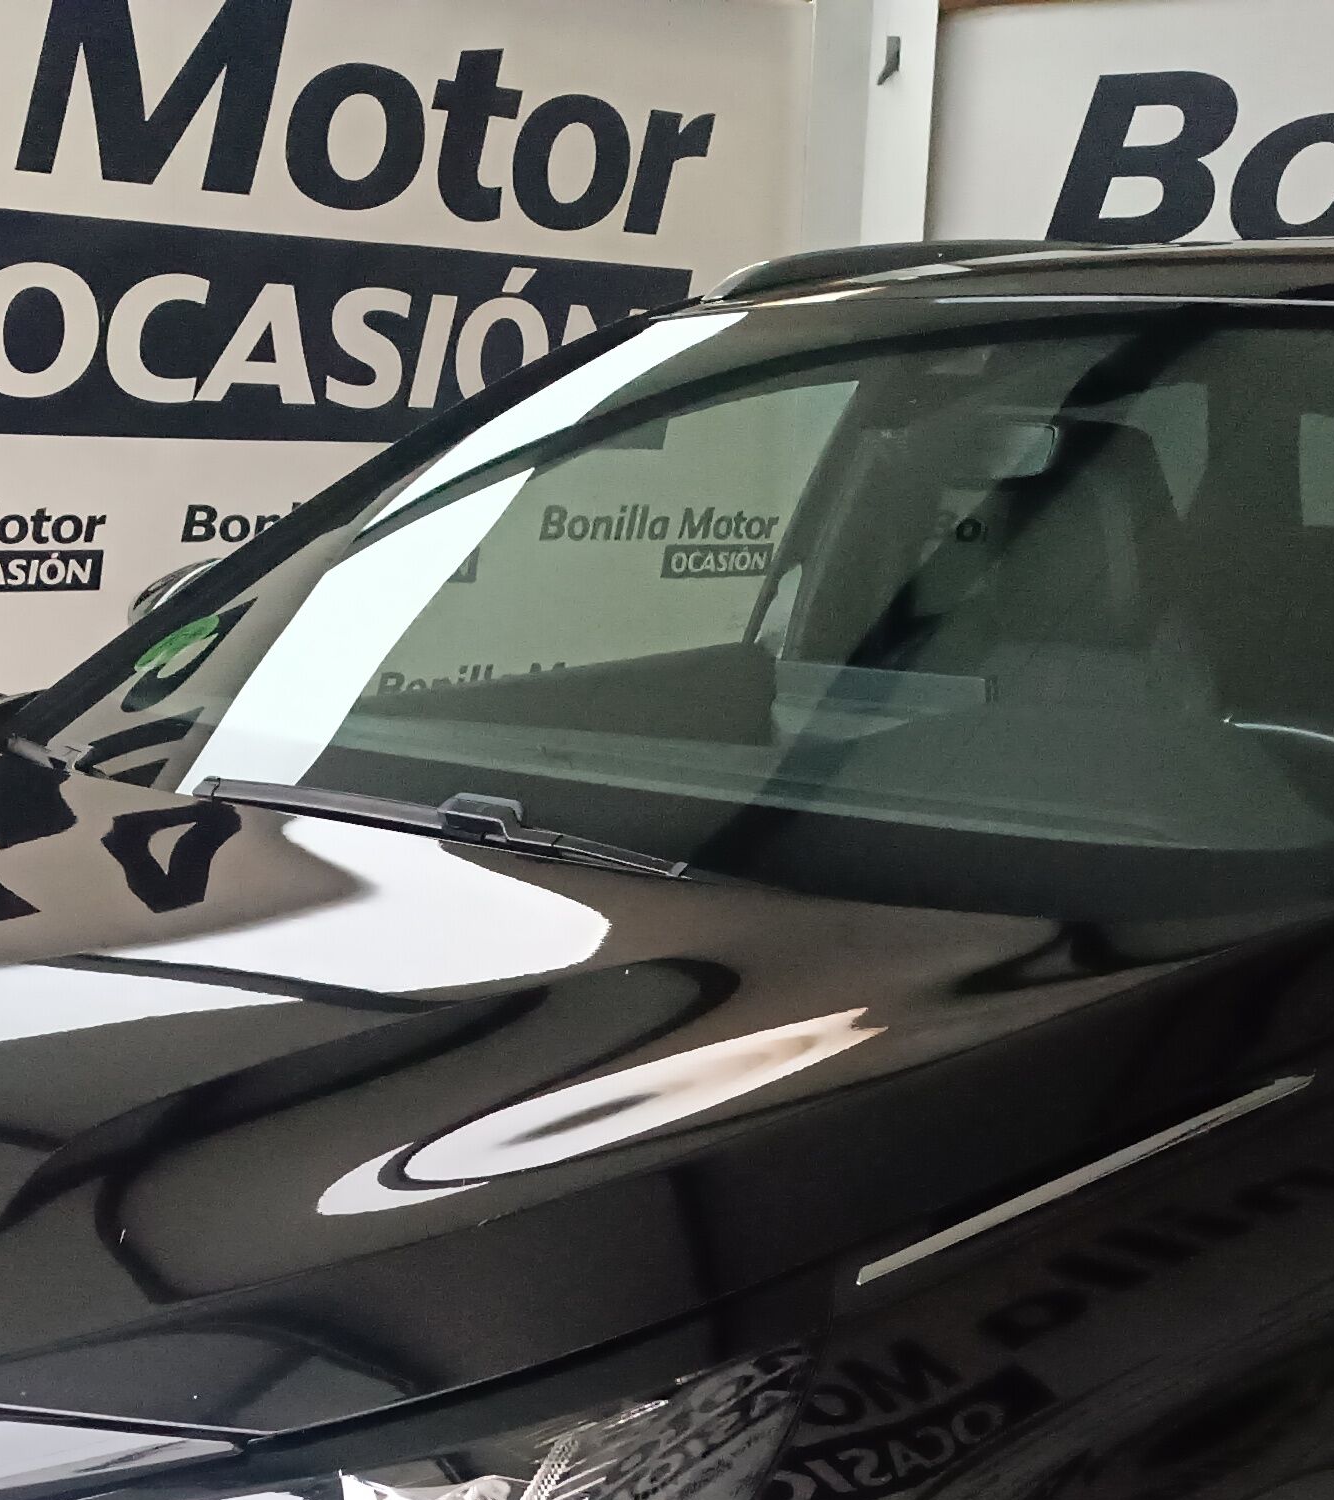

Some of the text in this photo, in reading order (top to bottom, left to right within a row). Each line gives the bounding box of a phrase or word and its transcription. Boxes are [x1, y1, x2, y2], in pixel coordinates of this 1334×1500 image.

[16, 0, 715, 235] Motor
[539, 504, 779, 542] Bonilla Motor
[671, 545, 766, 573] OCASIÓN
